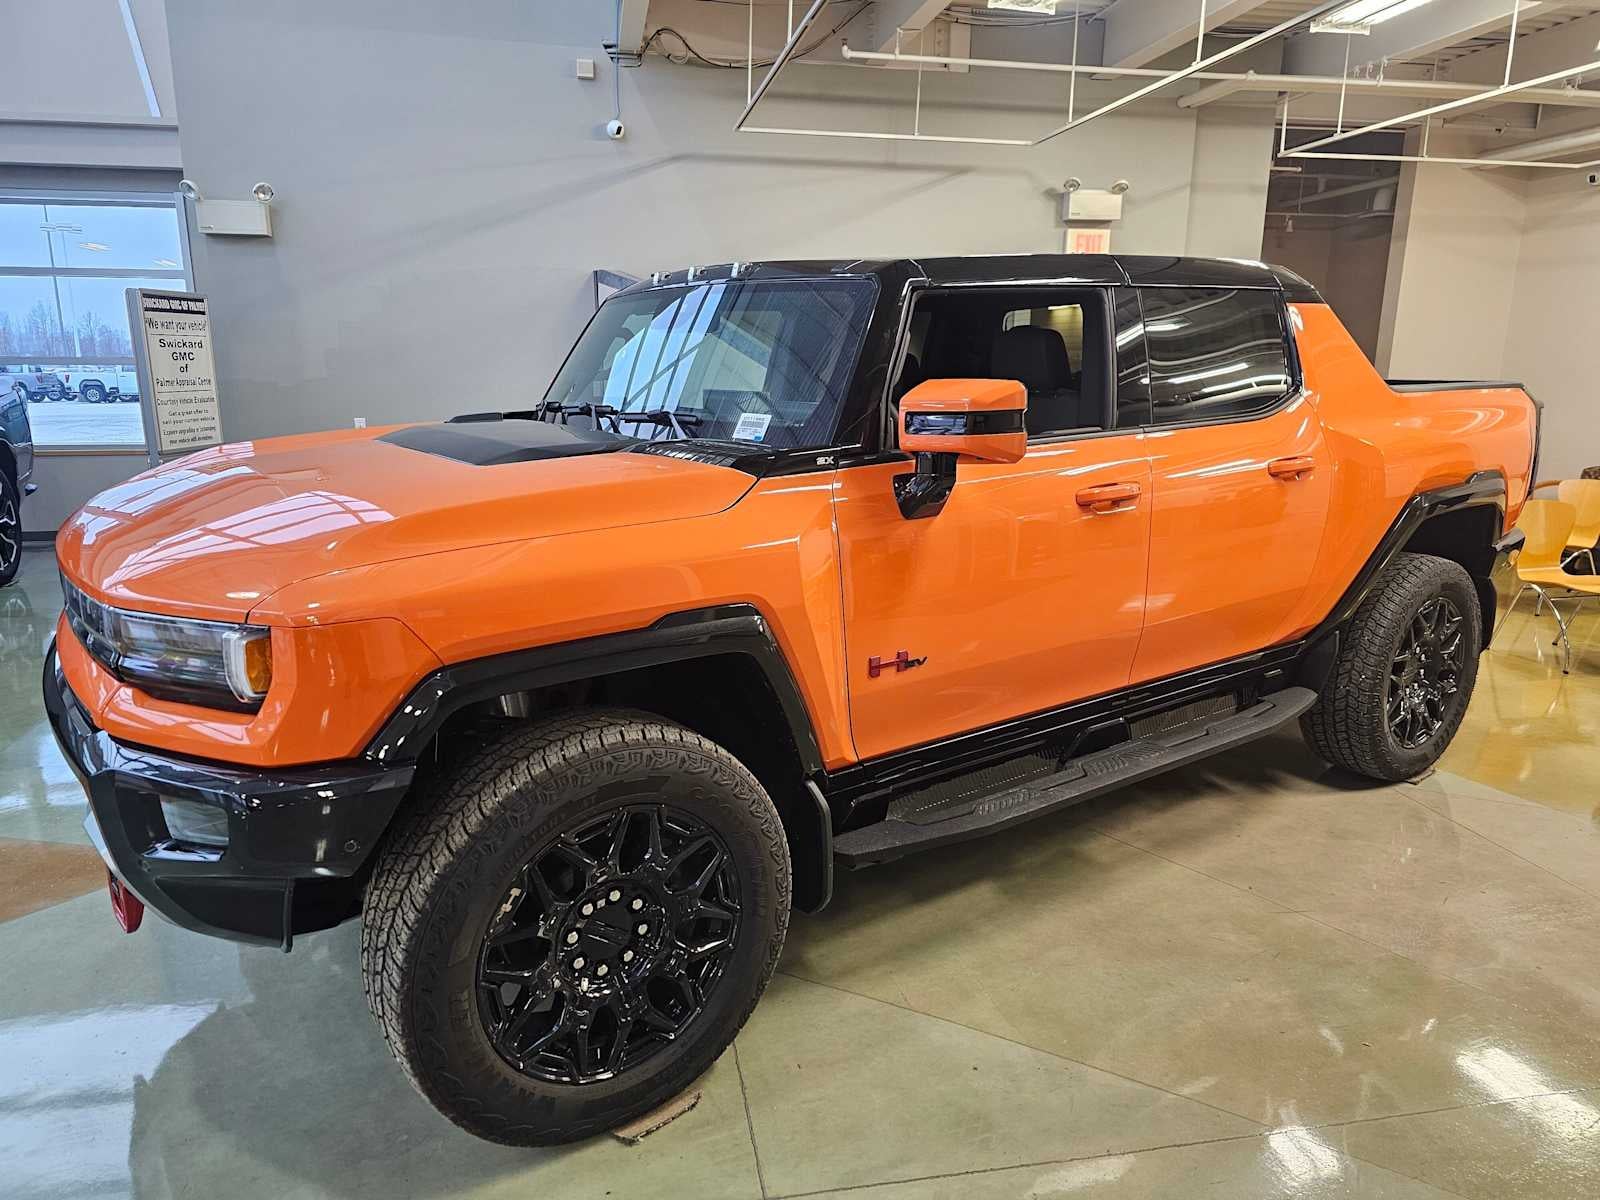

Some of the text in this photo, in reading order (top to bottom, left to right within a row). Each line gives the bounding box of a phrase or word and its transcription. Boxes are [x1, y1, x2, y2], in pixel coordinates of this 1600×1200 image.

[160, 320, 175, 330] want
[175, 321, 186, 333] your
[159, 338, 203, 349] Swickard
[171, 351, 195, 361] GMC
[179, 363, 189, 373] of
[155, 377, 176, 387] Palmer
[176, 377, 197, 387] Appraisal
